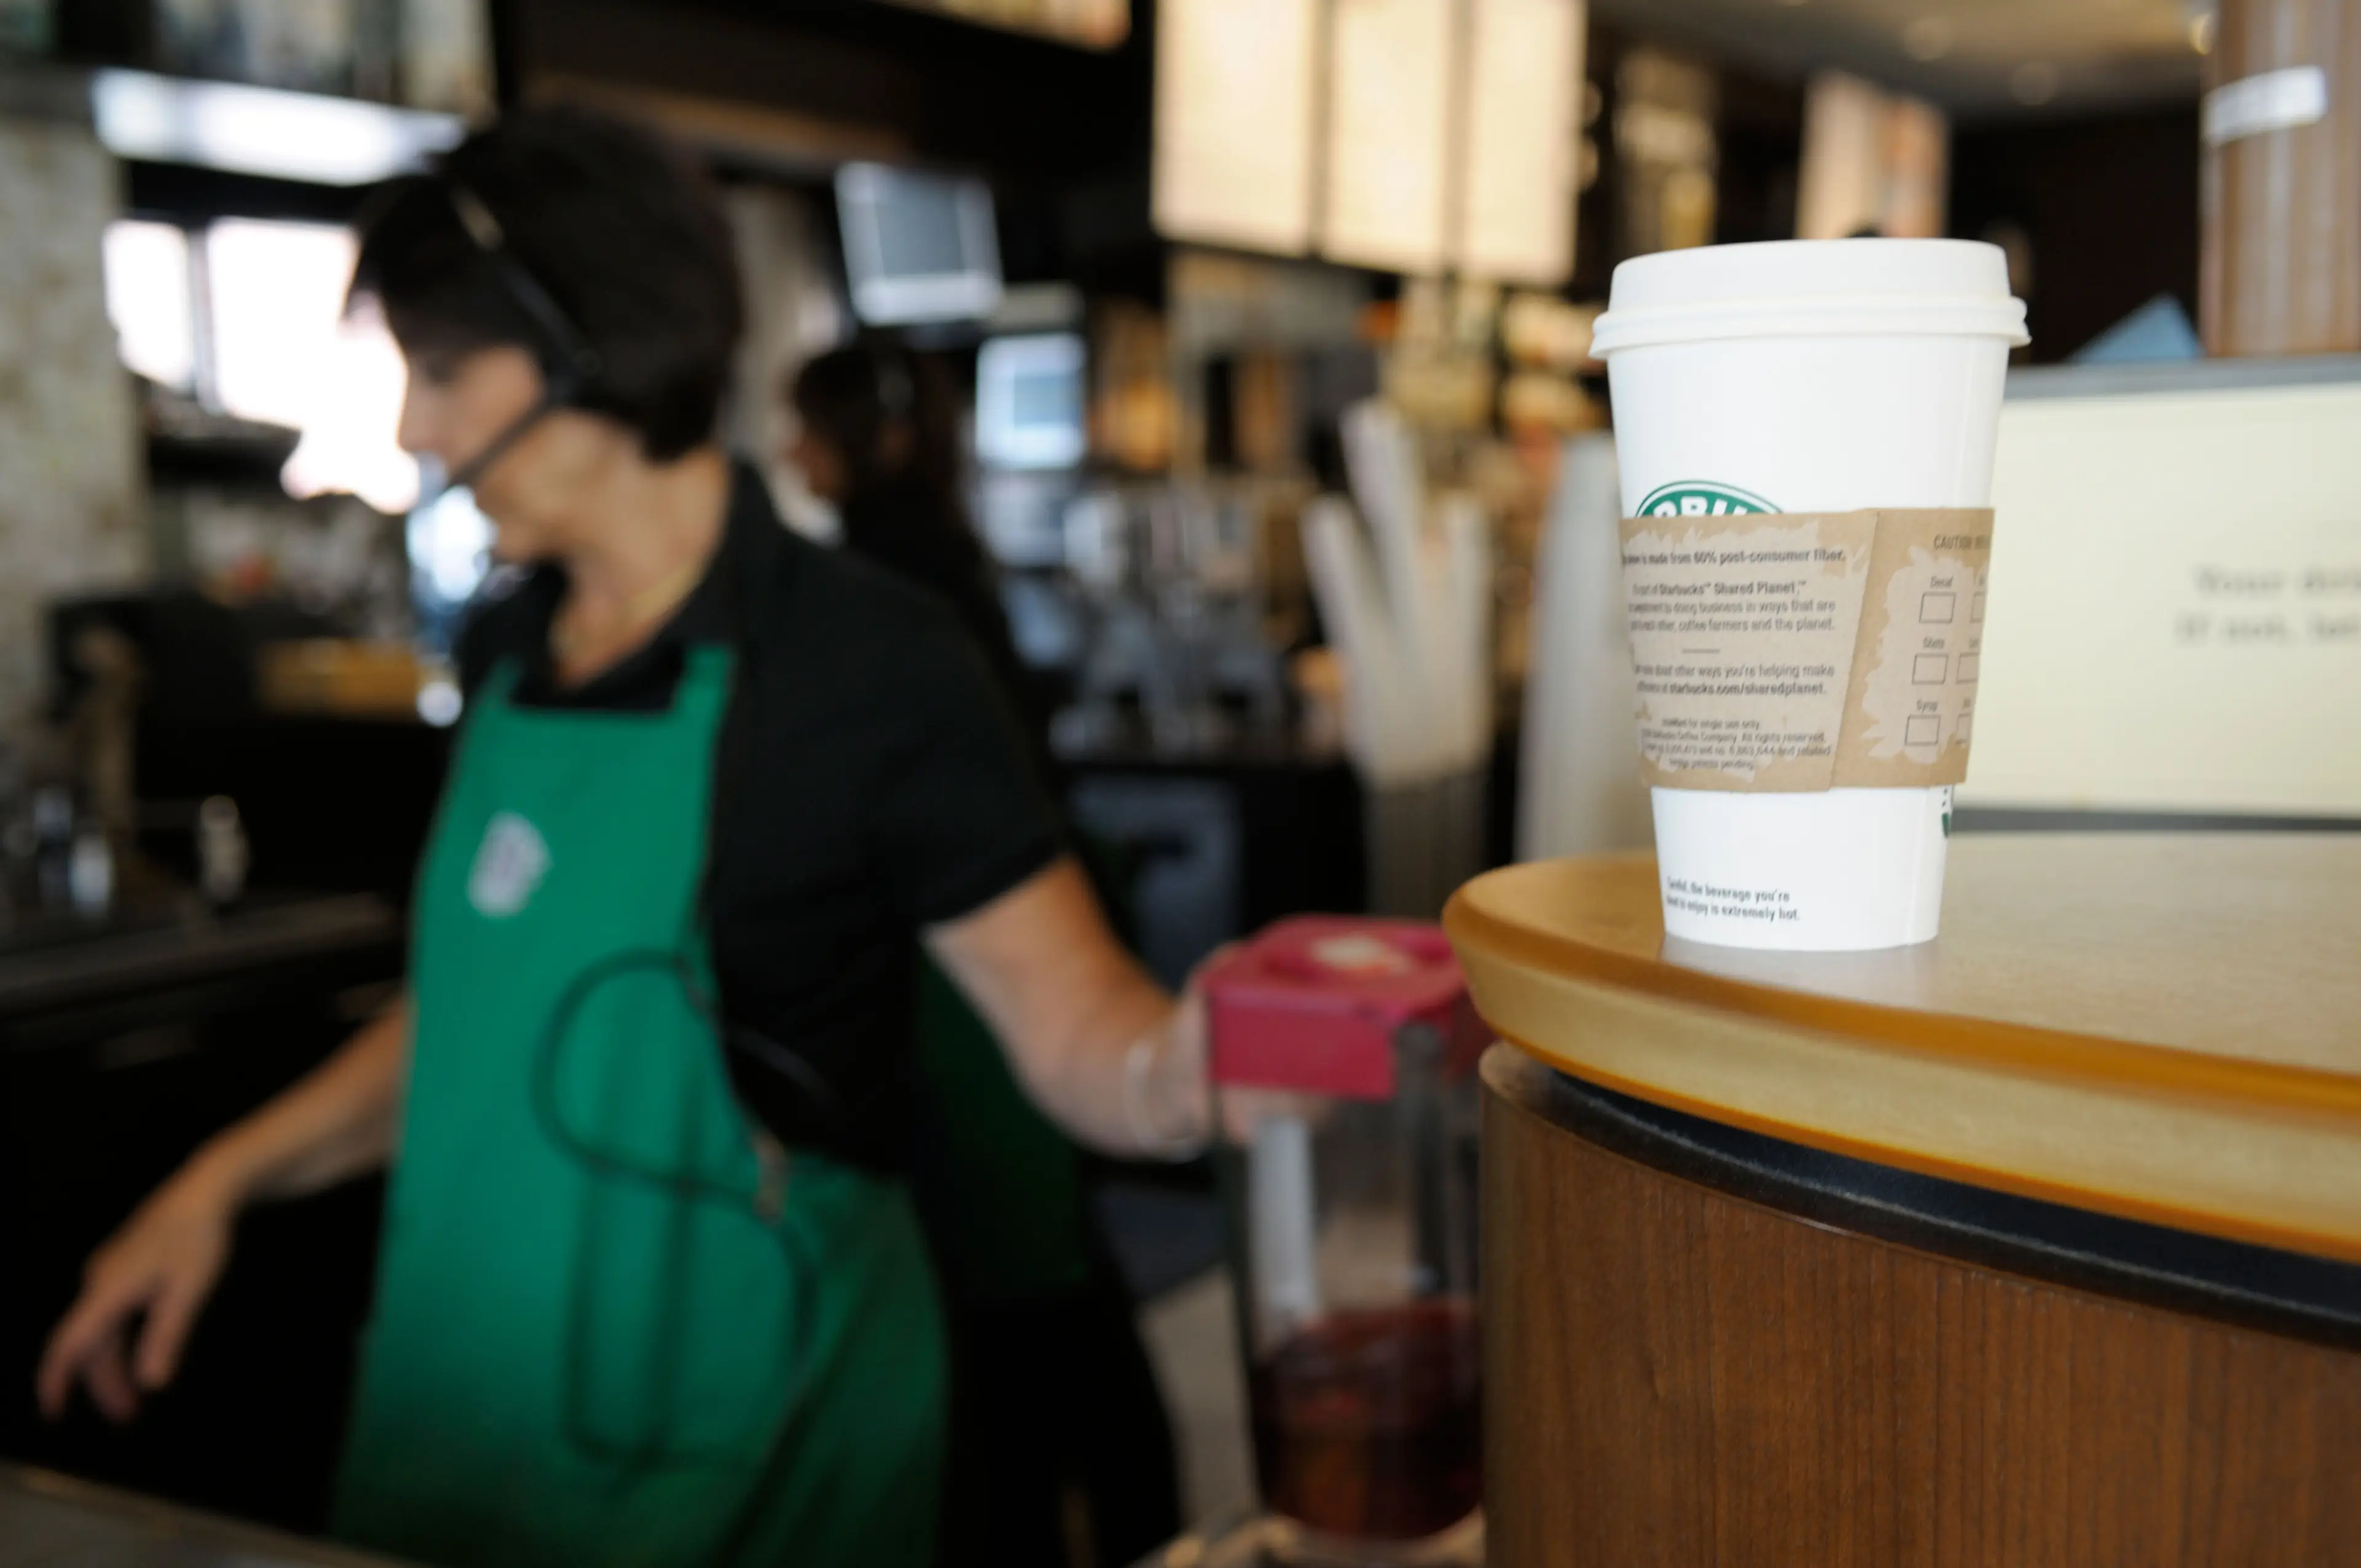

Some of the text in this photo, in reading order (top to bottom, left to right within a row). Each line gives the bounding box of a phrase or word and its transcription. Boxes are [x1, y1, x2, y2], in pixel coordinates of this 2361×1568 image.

[1719, 549, 1811, 566] post-consumer
[1714, 581, 1754, 597] Shared
[1699, 601, 1744, 613] business
[1760, 601, 1789, 615] ways
[1790, 598, 1814, 612] that
[1816, 600, 1837, 612] are
[1751, 617, 1772, 631] and
[1774, 617, 1793, 631] the
[1758, 663, 1800, 679] helping
[1801, 663, 1836, 677] make
[1705, 883, 1751, 902] beverage
[1755, 888, 1790, 904] you're
[1710, 902, 1719, 915] is
[1721, 905, 1776, 923] extremely
